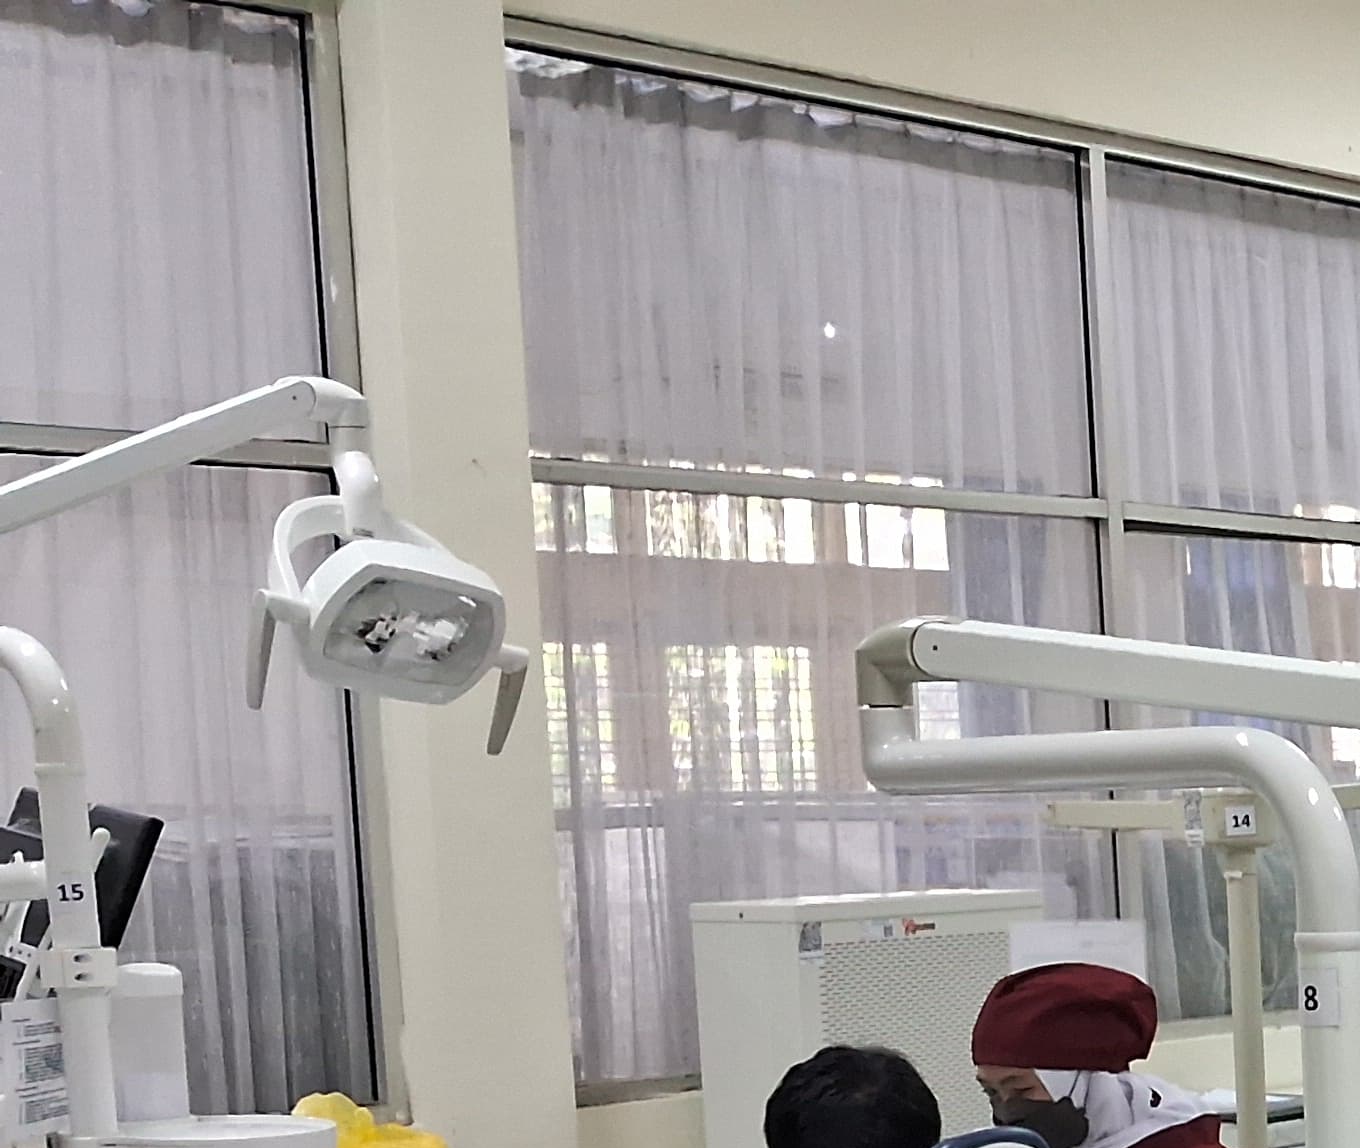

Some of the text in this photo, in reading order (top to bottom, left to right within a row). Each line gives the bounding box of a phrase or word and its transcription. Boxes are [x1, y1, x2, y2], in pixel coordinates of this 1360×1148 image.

[1231, 814, 1251, 828] 14
[57, 883, 84, 901] 15
[1303, 985, 1319, 1011] 8
